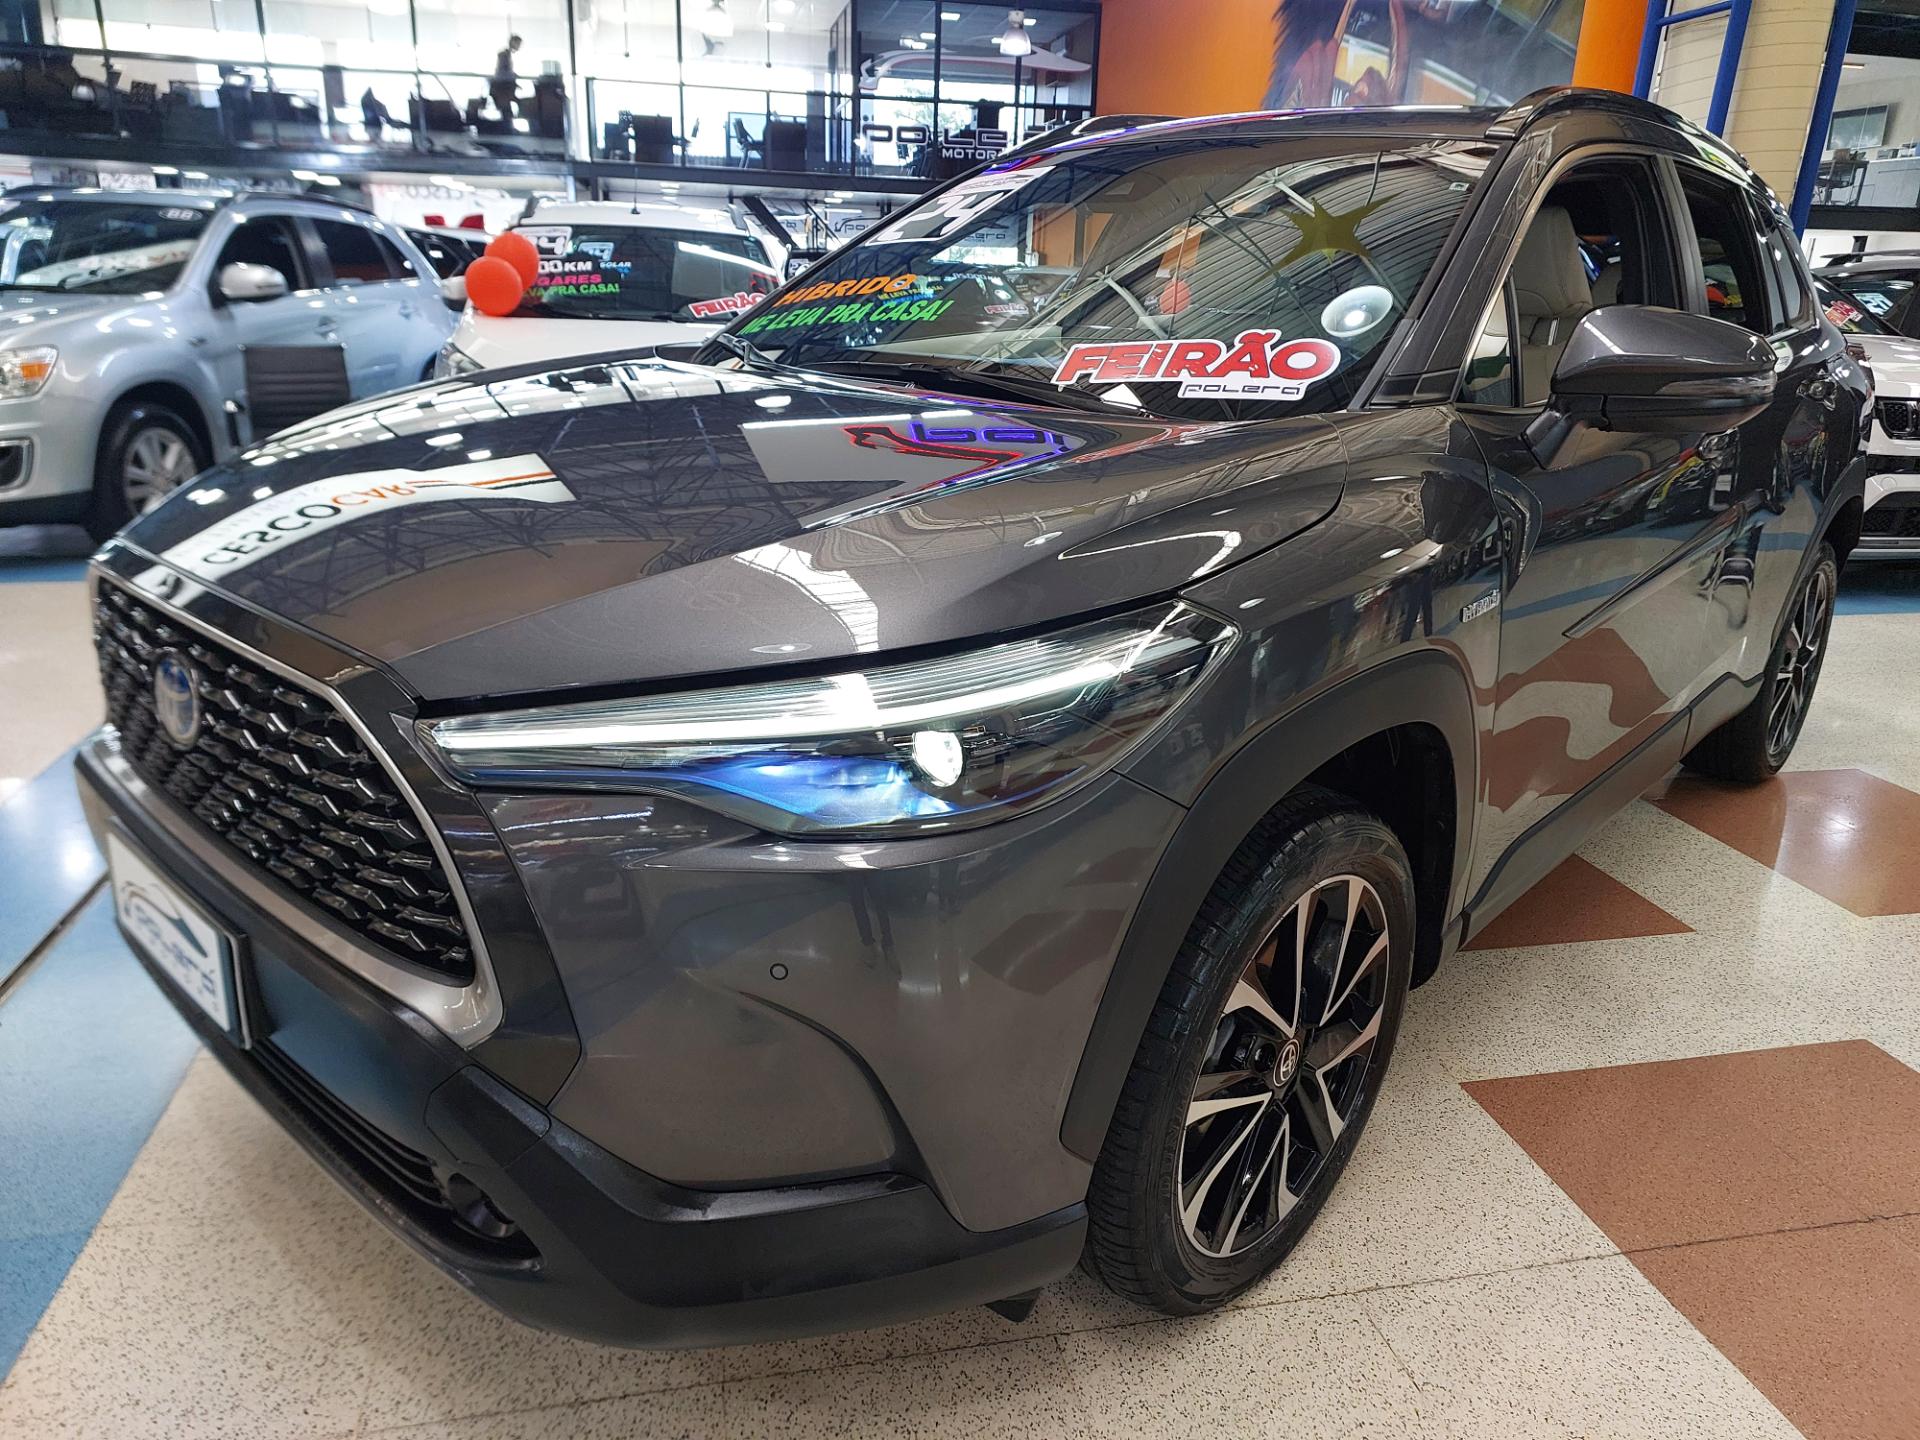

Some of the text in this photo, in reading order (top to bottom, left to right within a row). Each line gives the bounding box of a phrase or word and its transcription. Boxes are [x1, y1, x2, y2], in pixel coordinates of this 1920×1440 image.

[942, 149, 1002, 160] MOTOR
[533, 274, 602, 286] GARES
[766, 306, 827, 331] LEVA
[819, 302, 874, 324] PRA
[869, 300, 955, 322] CASA!
[1054, 331, 1337, 381] FEIRÃO
